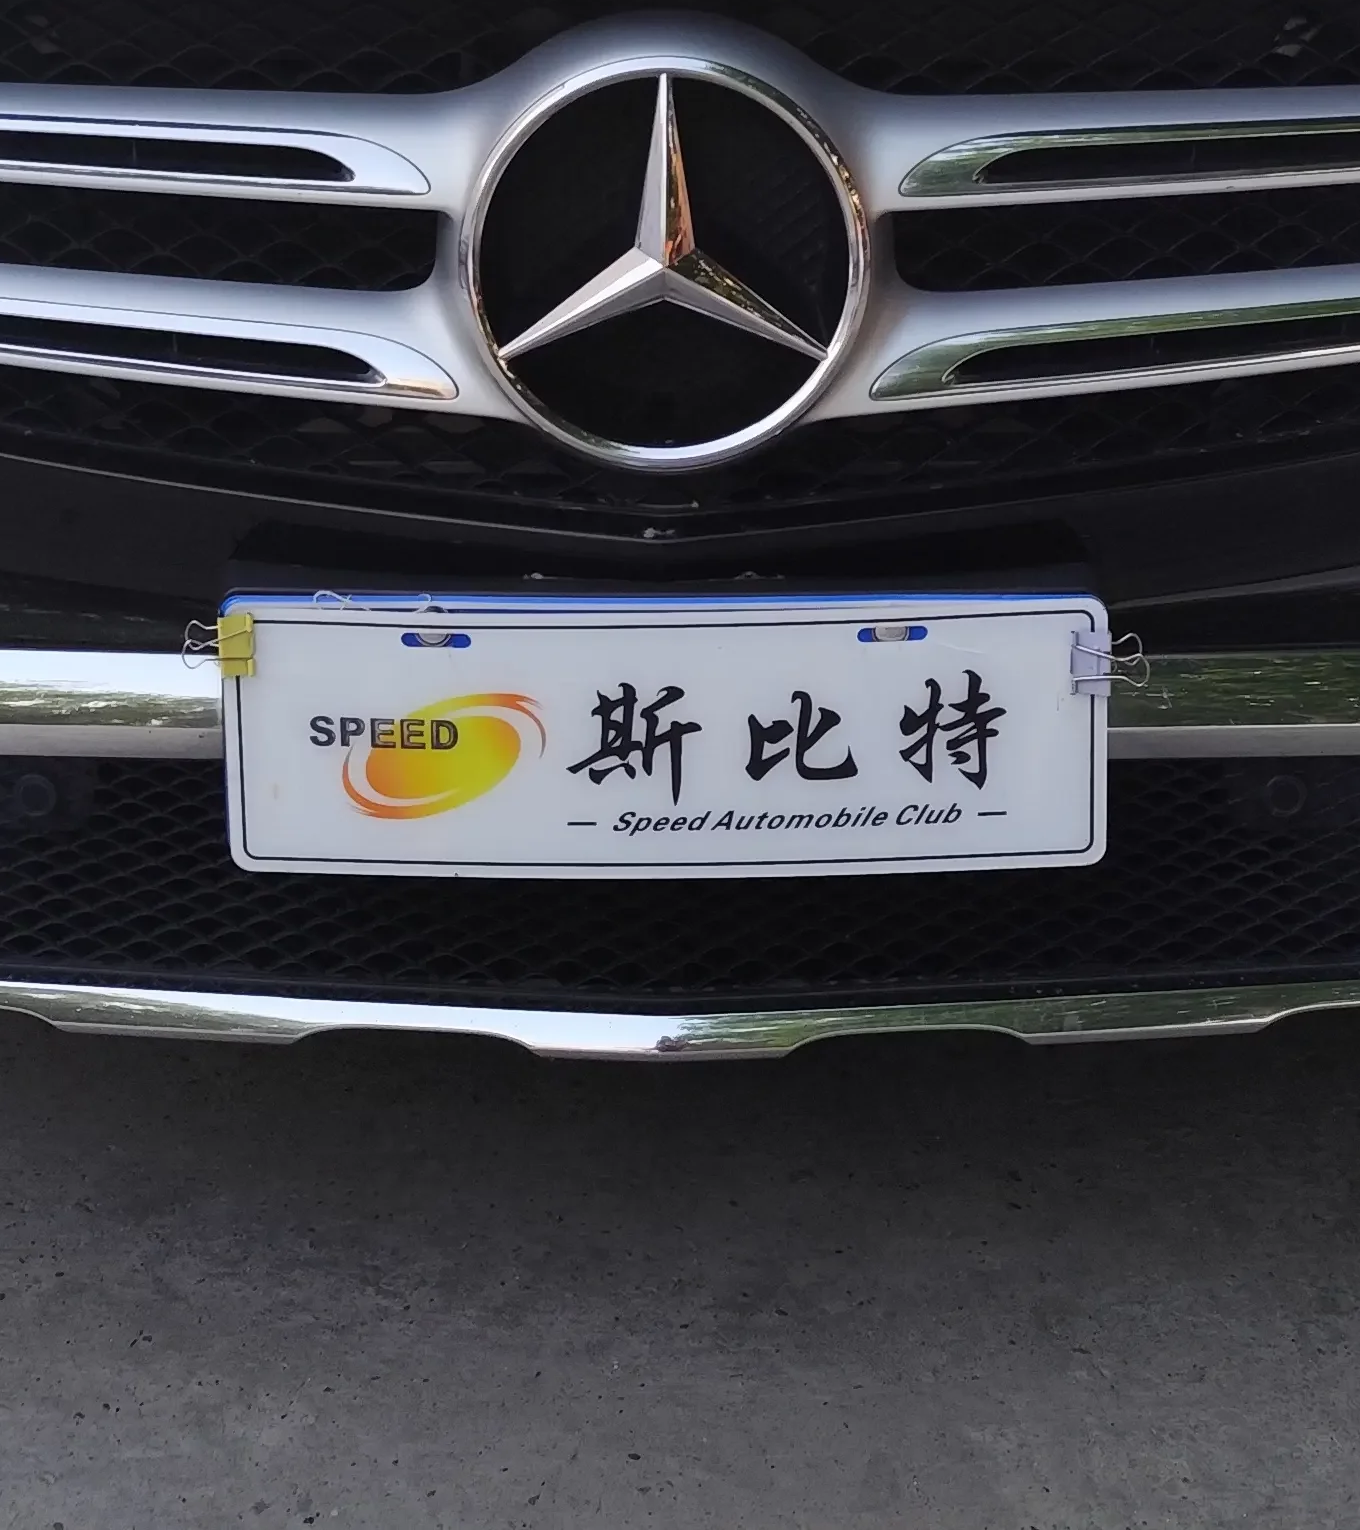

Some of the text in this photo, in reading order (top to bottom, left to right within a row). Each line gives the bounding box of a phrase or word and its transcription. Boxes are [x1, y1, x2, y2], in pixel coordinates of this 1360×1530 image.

[309, 714, 460, 751] SPEED
[566, 668, 1008, 807] 斯比特
[612, 802, 964, 837] Speed Automobile Club
